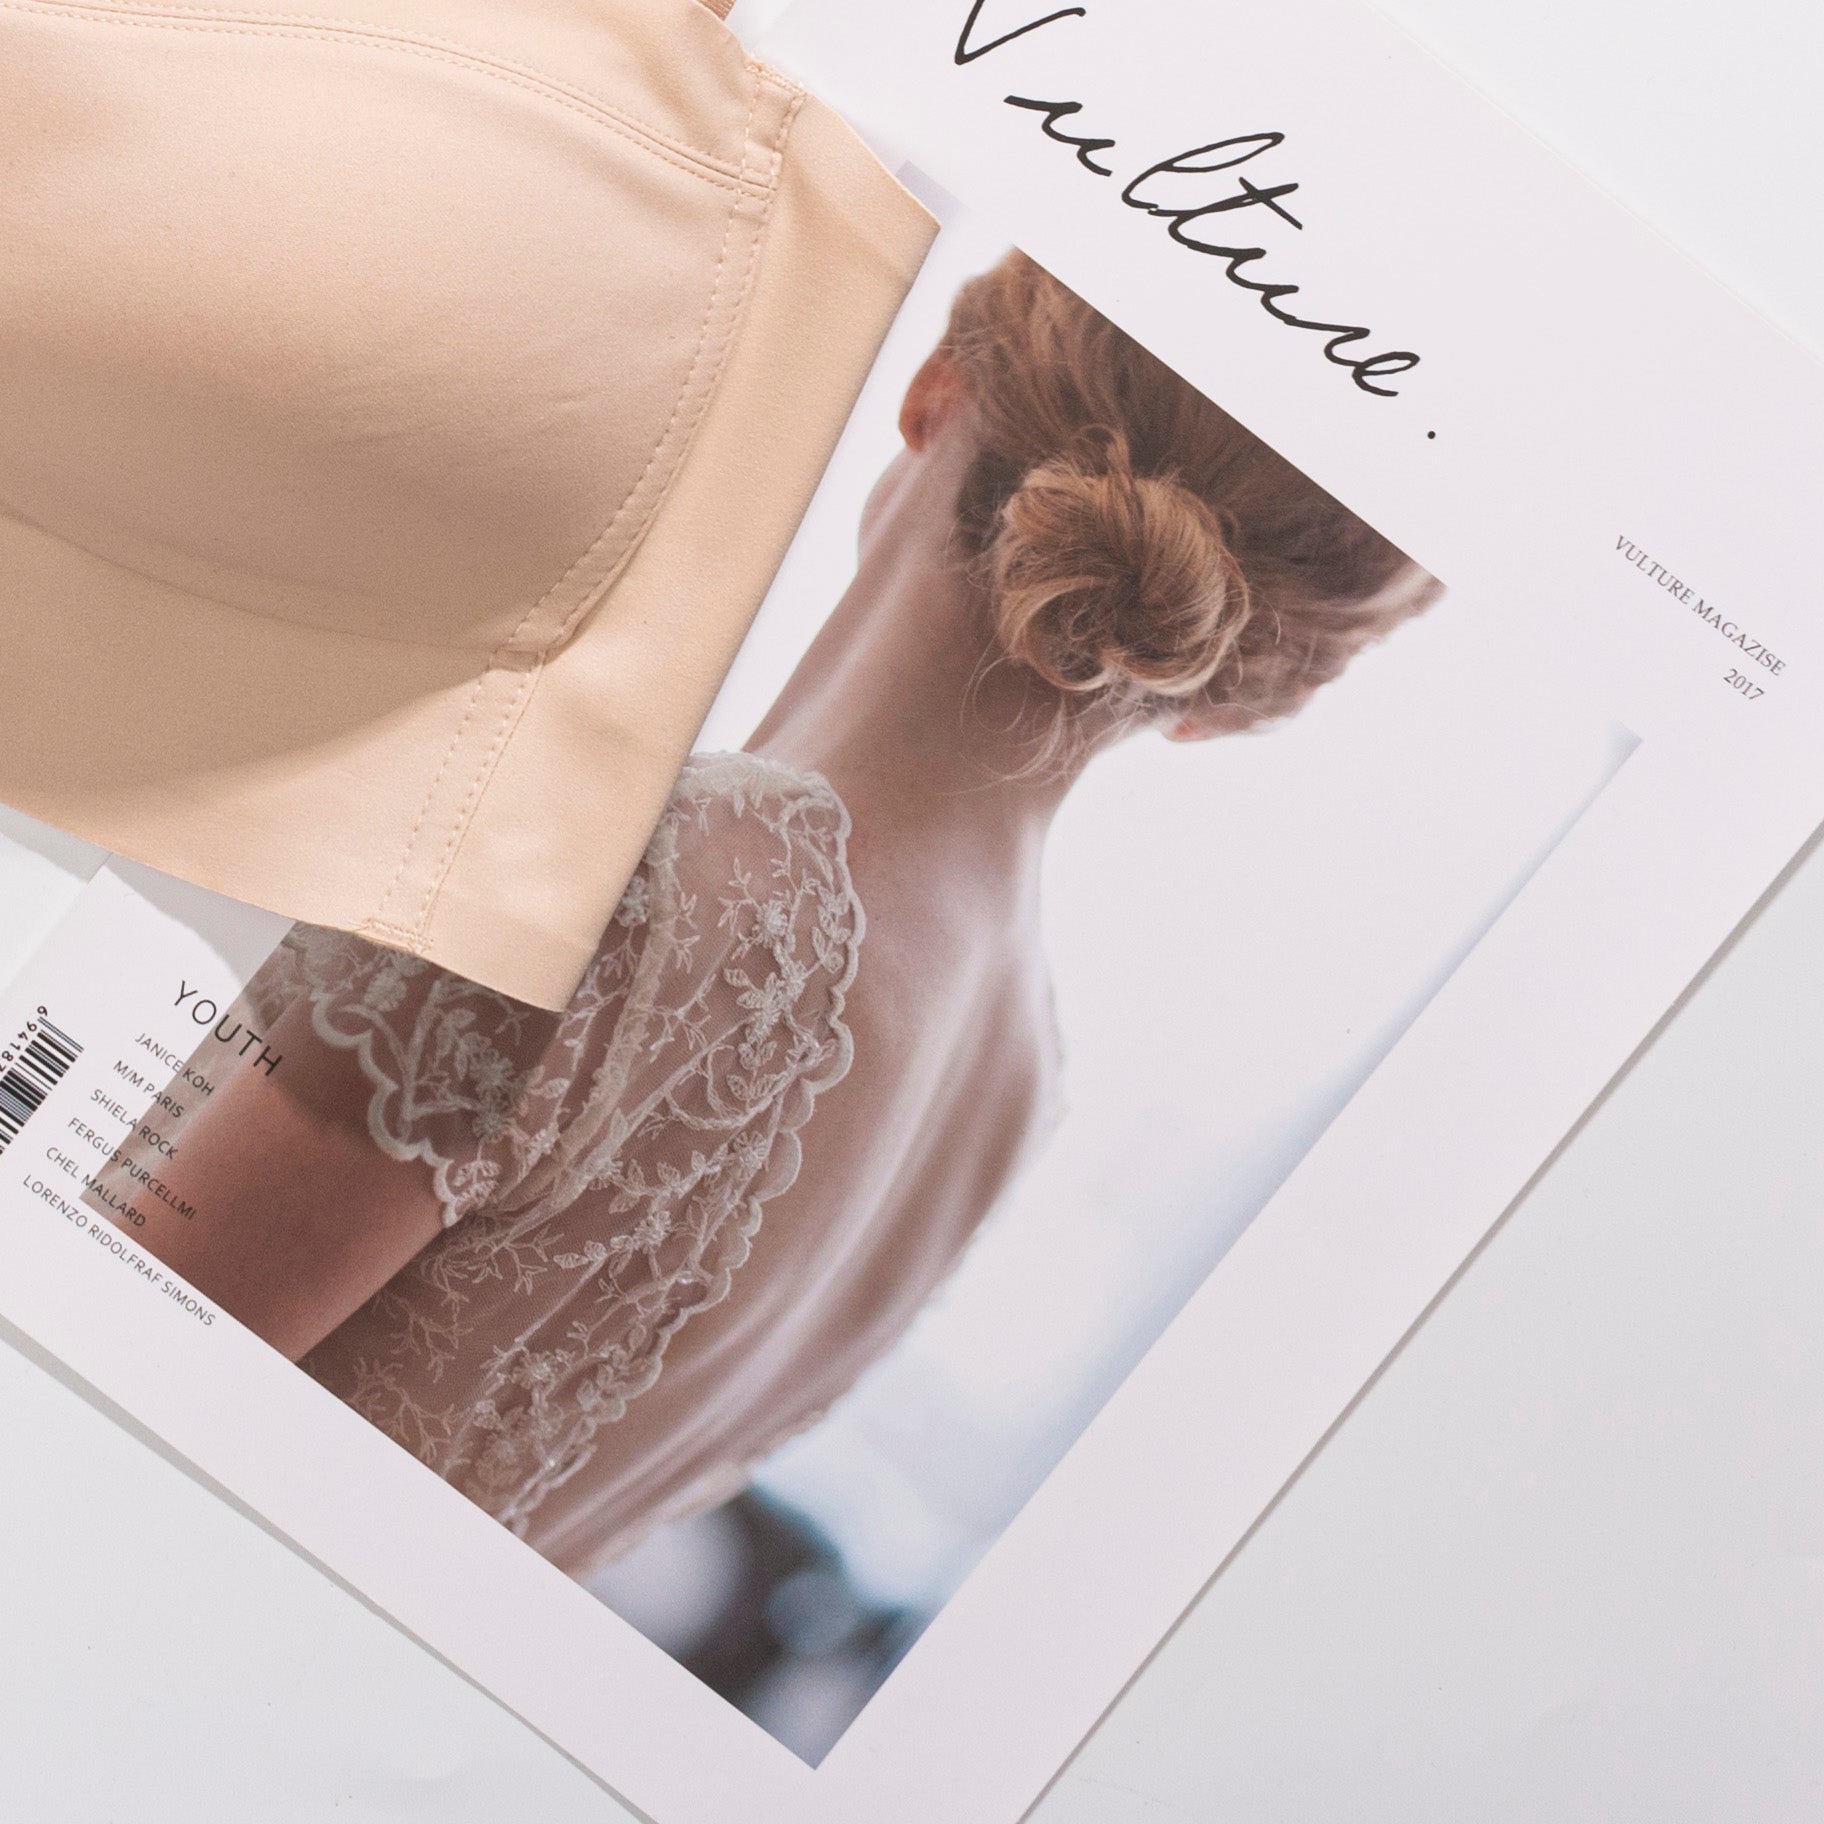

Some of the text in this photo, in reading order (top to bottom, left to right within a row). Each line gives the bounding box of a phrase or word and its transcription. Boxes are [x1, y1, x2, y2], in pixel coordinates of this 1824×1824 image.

[1614, 534, 1786, 676] VULTURE MAGAZISE
[1723, 668, 1765, 701] 2017
[134, 1033, 215, 1096] JANICE KOH
[174, 980, 283, 1076] YOUTH
[90, 1088, 178, 1160] SHIELA ROCK
[113, 1060, 185, 1118] M/M PARIS
[46, 1146, 146, 1227] CHEL MALLARD
[67, 1117, 197, 1221] FERGUS PURCELLMI
[22, 1174, 216, 1327] LORENZO RIDOLFRAF SIMONS
